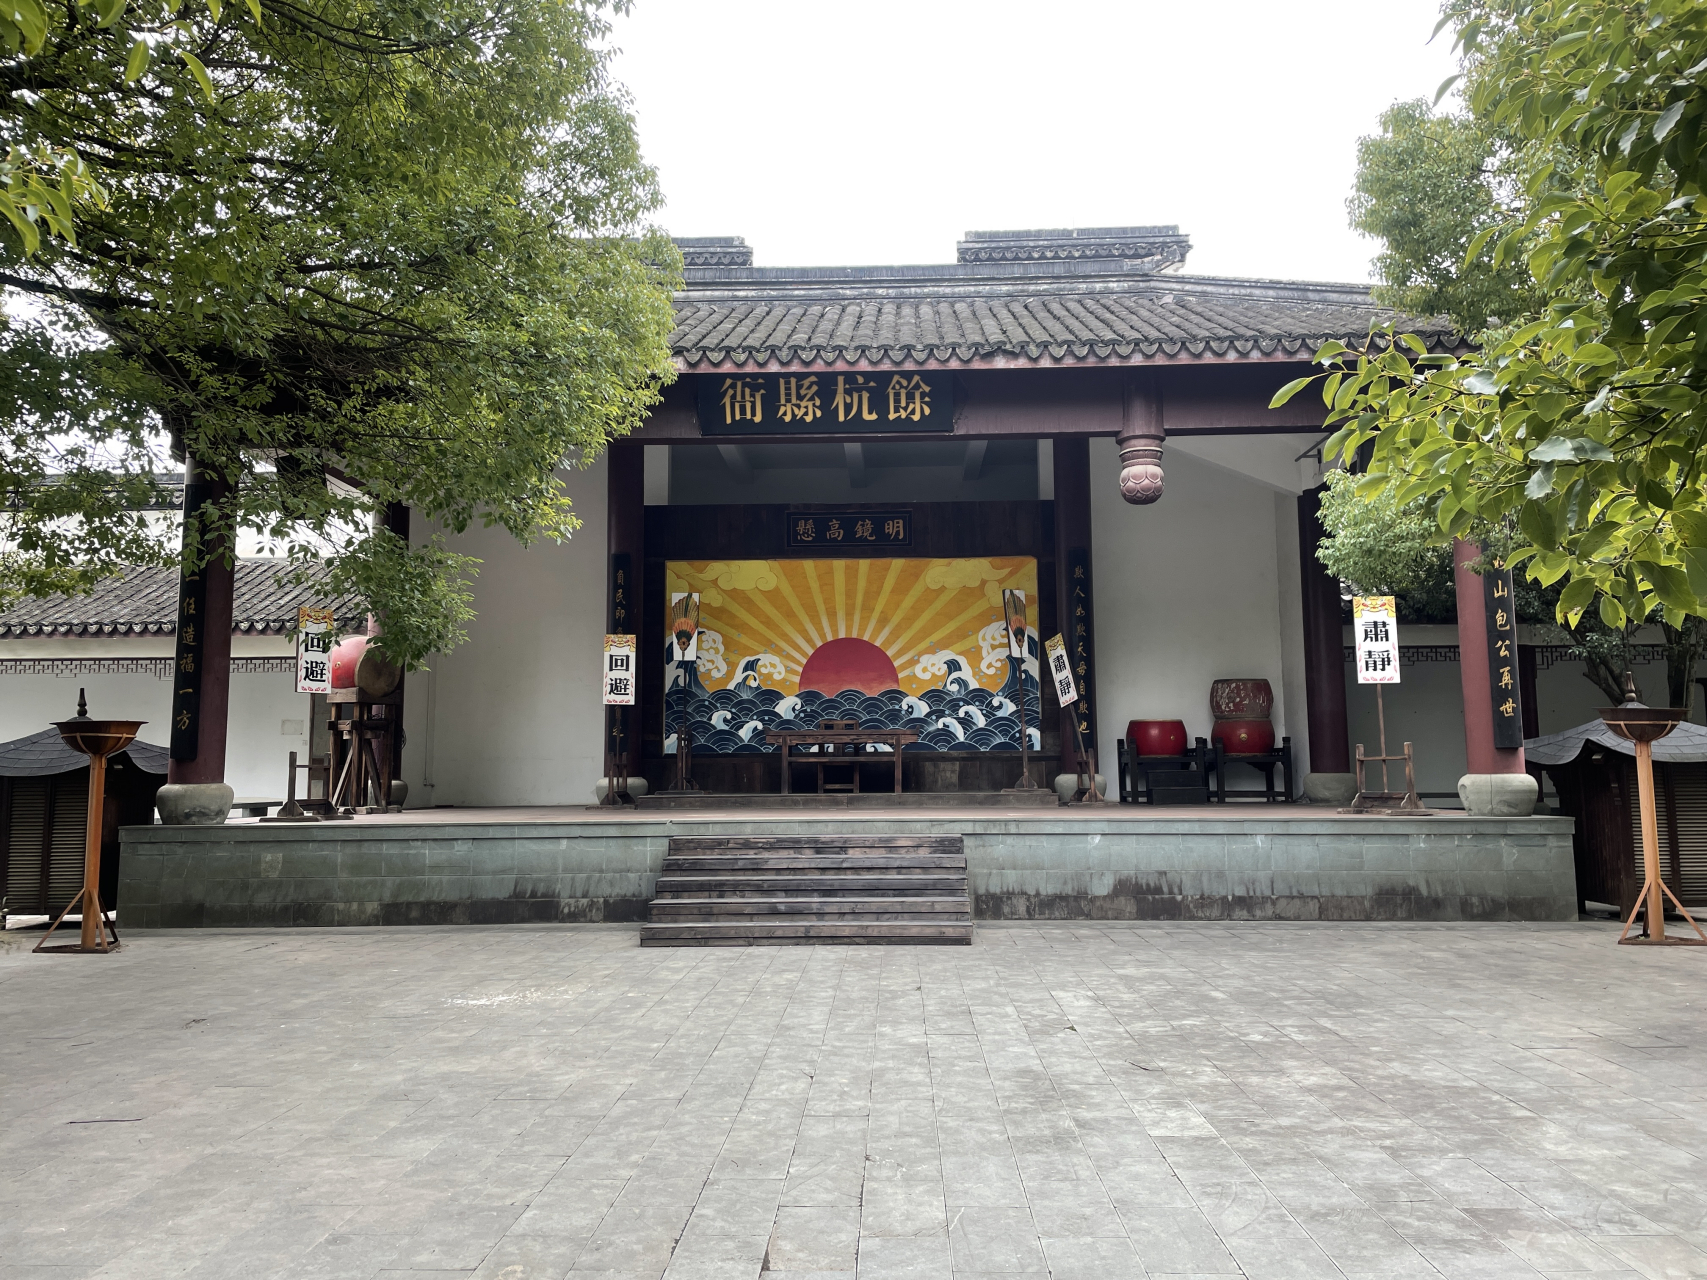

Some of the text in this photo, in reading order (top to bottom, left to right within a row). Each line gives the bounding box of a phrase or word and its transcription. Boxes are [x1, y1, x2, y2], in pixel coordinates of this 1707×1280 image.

[719, 374, 933, 425] 餘杭縣衙
[795, 518, 905, 541] 明鏡高懸
[1361, 620, 1393, 672] 肅靜
[608, 653, 630, 697] 回避
[1052, 653, 1072, 697] 肅靜
